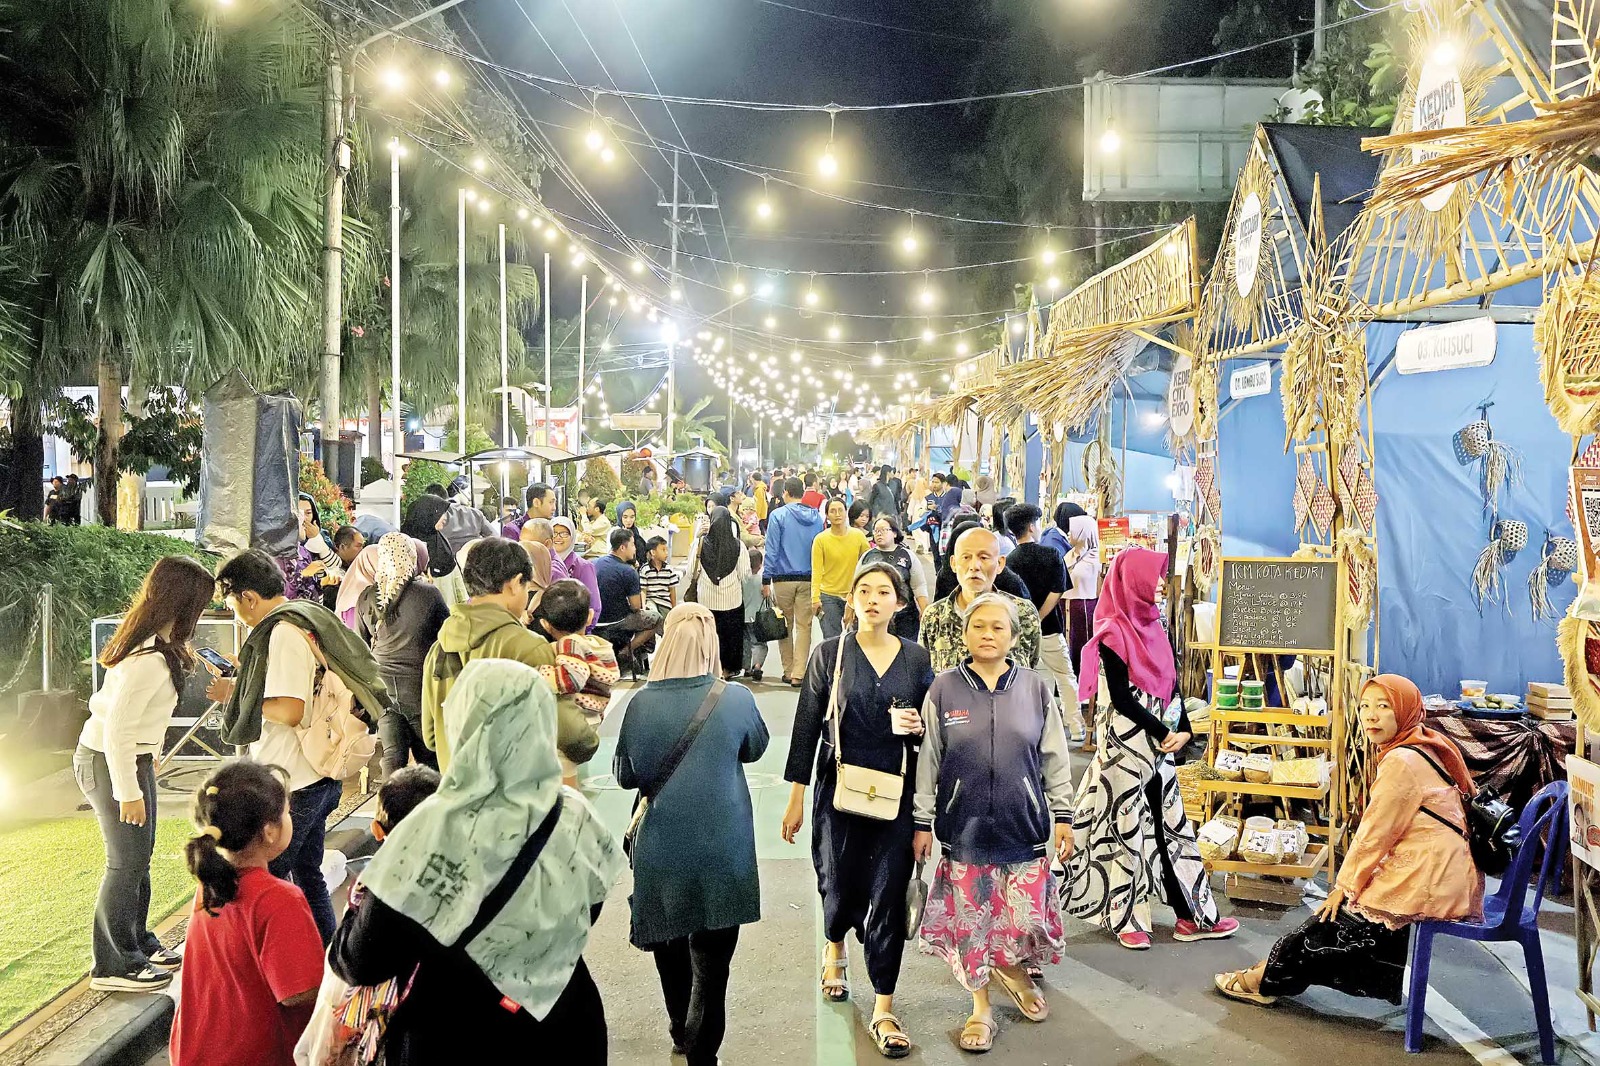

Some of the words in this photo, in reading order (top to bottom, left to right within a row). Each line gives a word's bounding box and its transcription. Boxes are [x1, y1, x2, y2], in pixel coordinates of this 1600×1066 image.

[1420, 79, 1456, 126] KEDIRI
[1240, 212, 1259, 240] KEDIRI
[1172, 385, 1187, 402] CITY
[1171, 400, 1190, 418] EXPO
[1231, 562, 1253, 580] IKM
[1256, 564, 1282, 580] KOTA
[1284, 565, 1324, 580] KEDIRI
